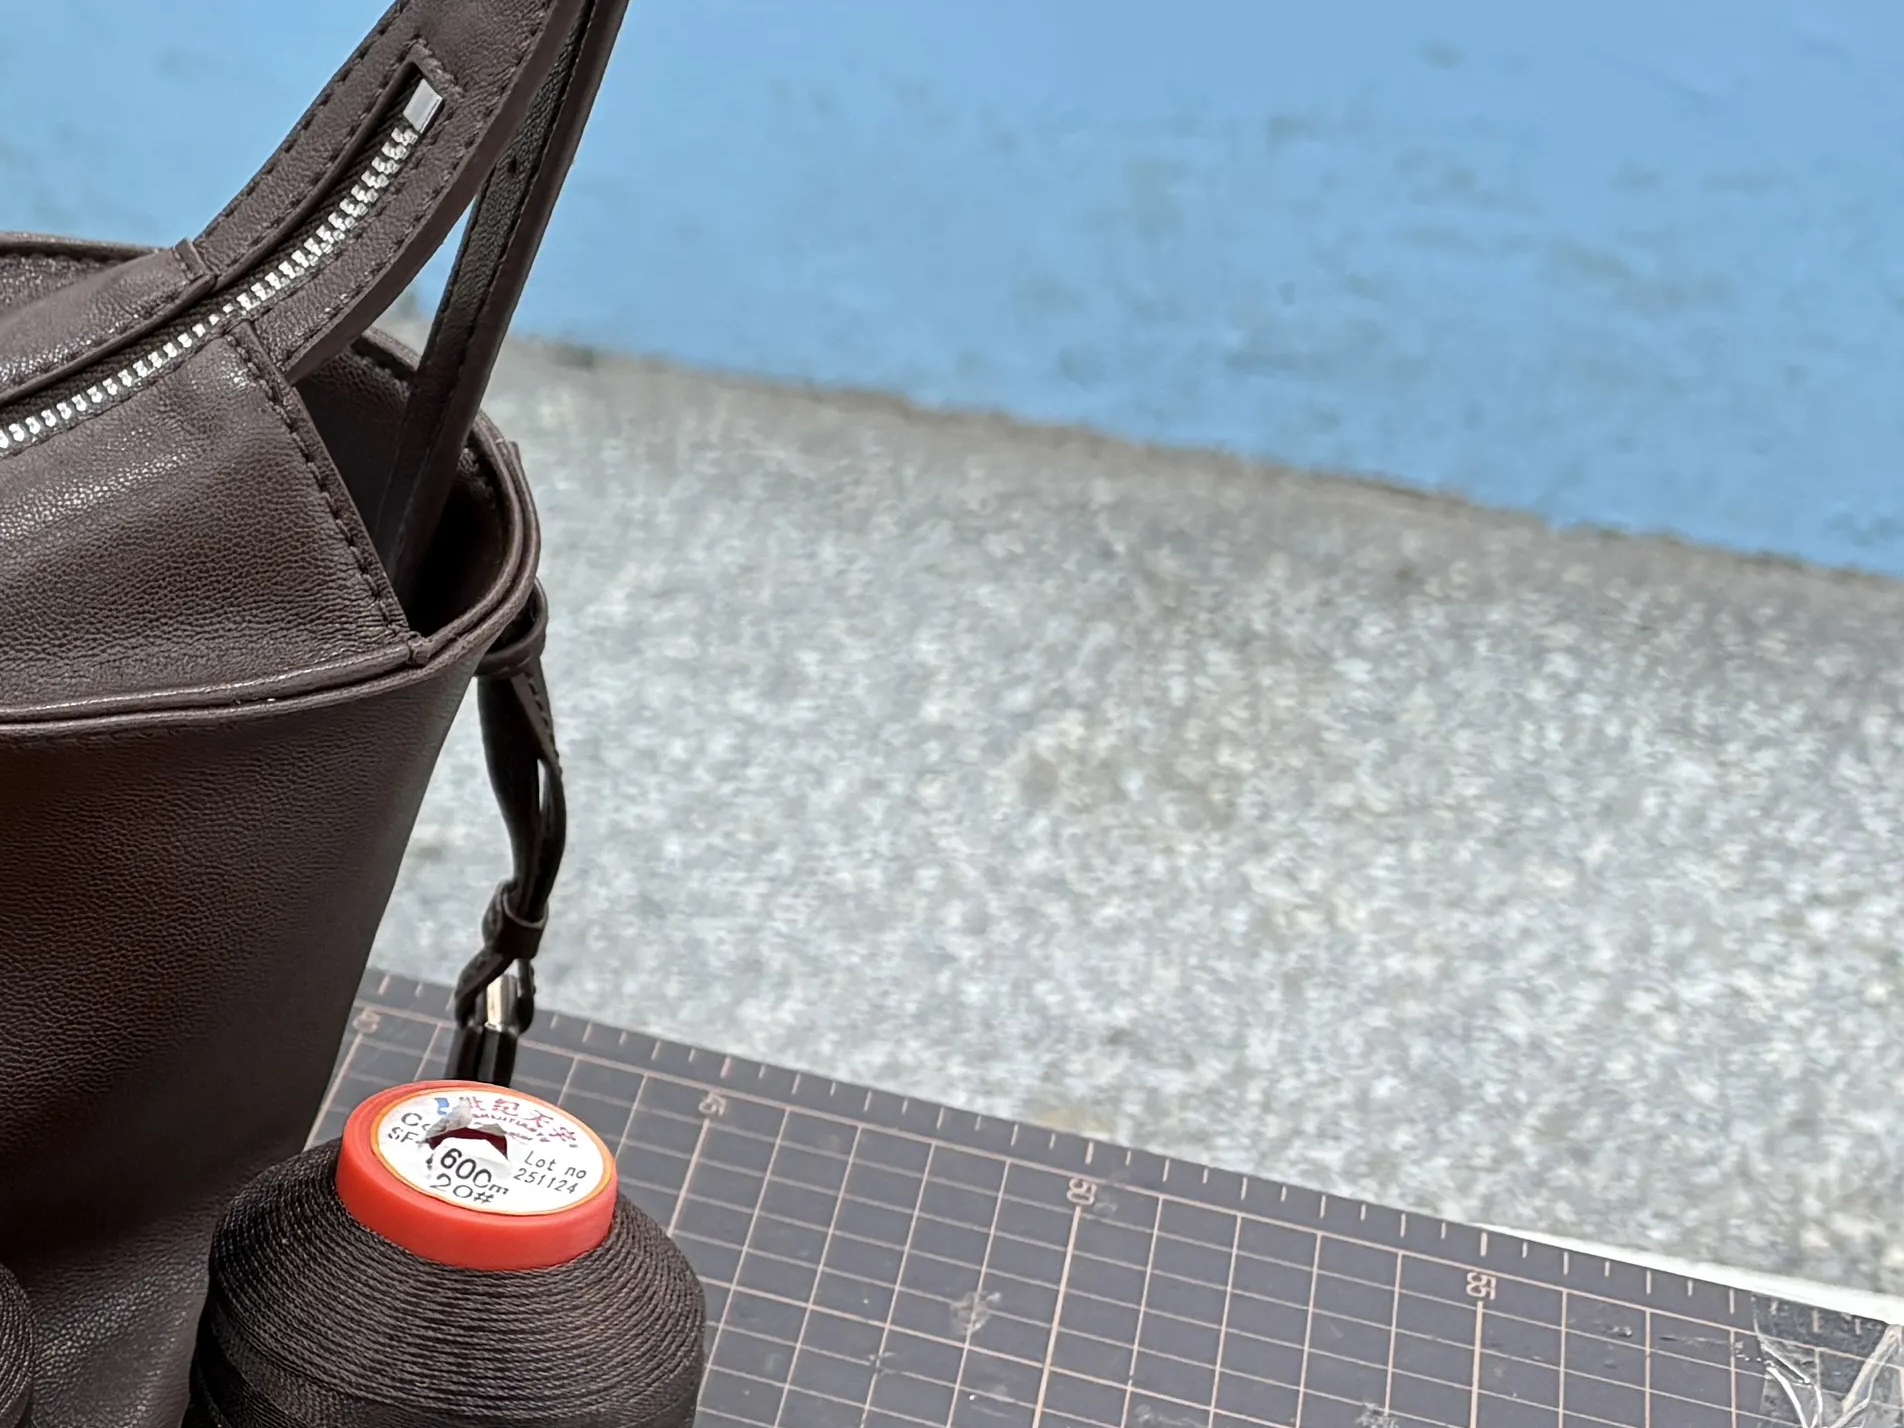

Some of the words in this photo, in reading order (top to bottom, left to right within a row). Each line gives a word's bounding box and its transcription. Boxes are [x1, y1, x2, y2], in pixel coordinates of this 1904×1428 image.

[524, 1150, 556, 1171] Lot
[564, 1166, 587, 1179] no
[430, 1172, 494, 1204] 20#
[513, 1167, 578, 1194] 251124
[1067, 1177, 1096, 1204] 50
[1466, 1272, 1496, 1300] 55
